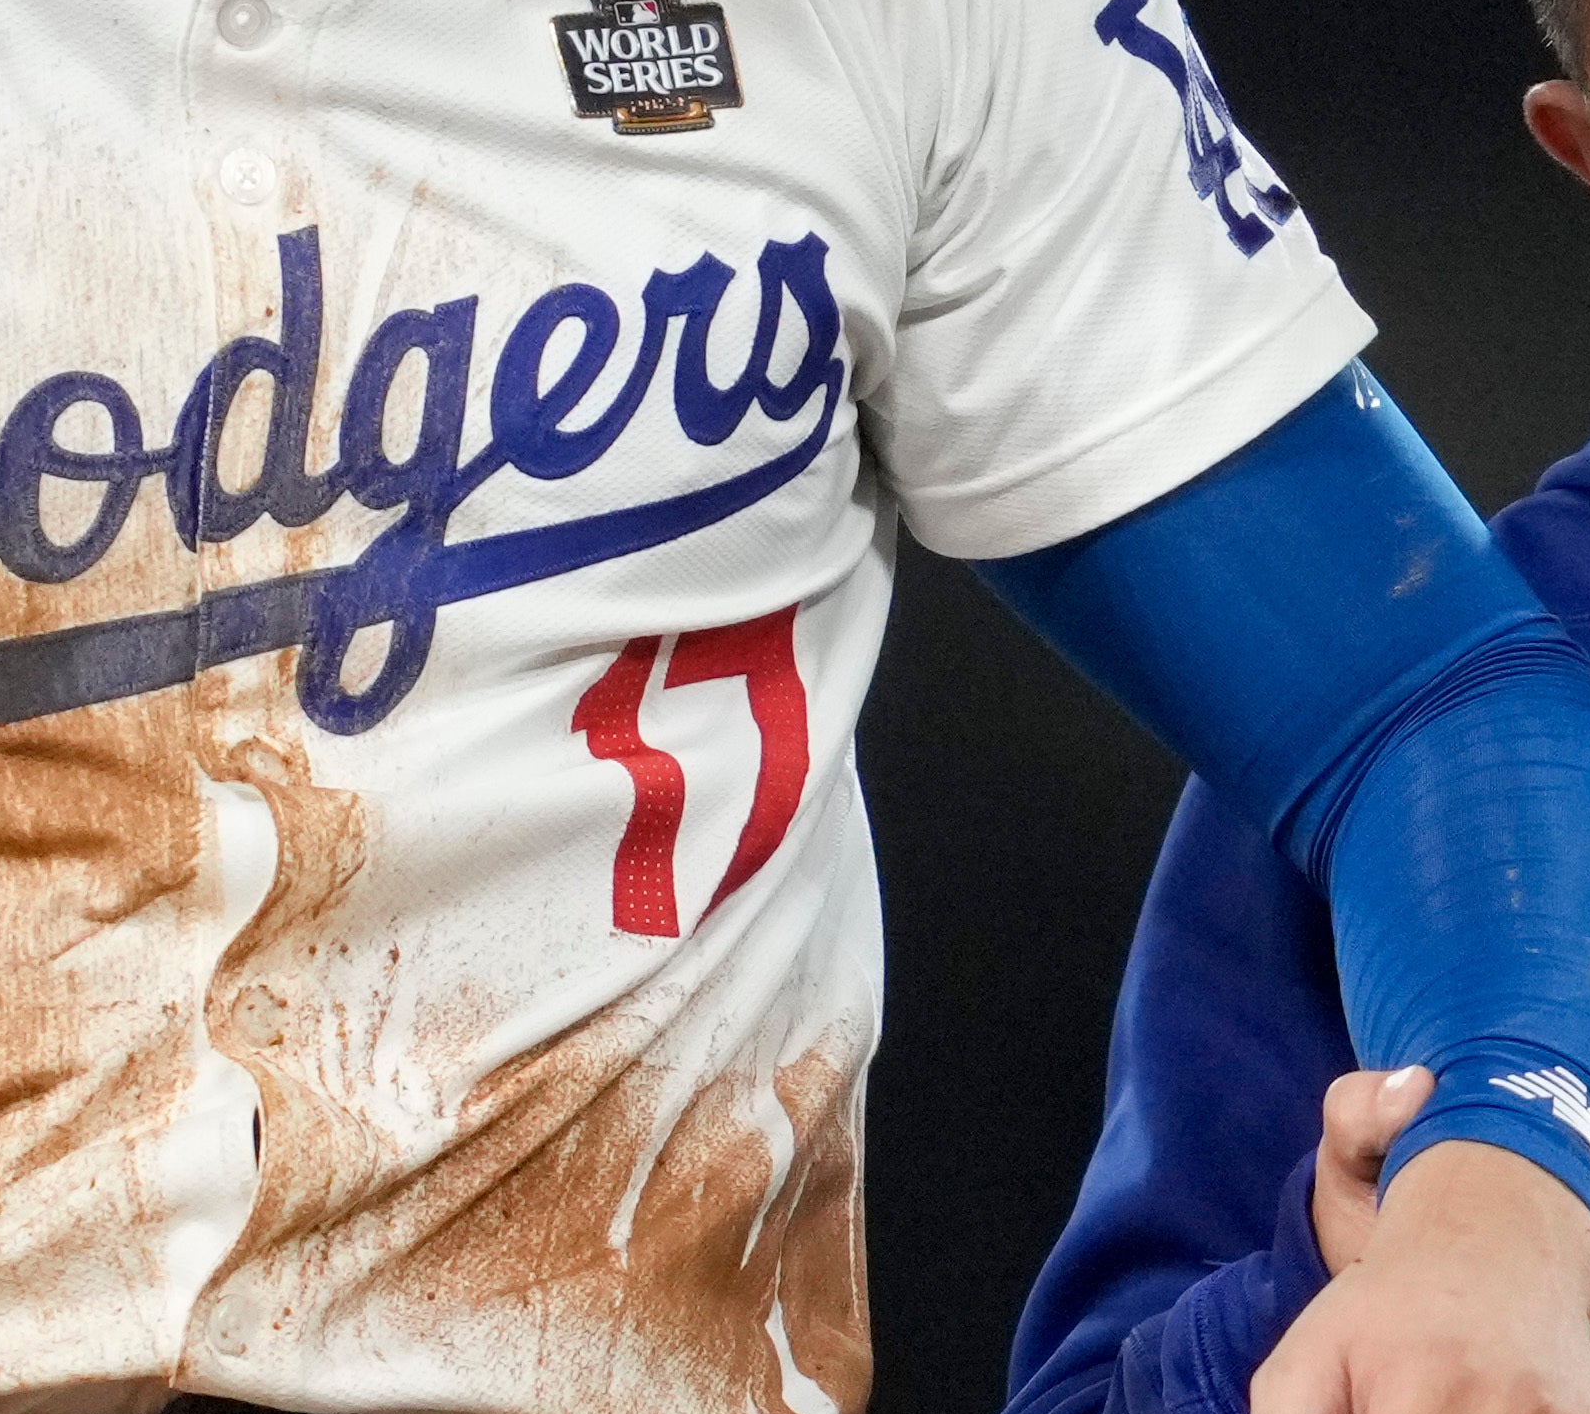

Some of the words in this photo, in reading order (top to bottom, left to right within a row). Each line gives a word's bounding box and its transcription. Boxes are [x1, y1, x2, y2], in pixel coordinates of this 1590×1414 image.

[566, 23, 720, 63] WORLD
[583, 55, 724, 95] SERIES
[571, 601, 813, 939] 17
